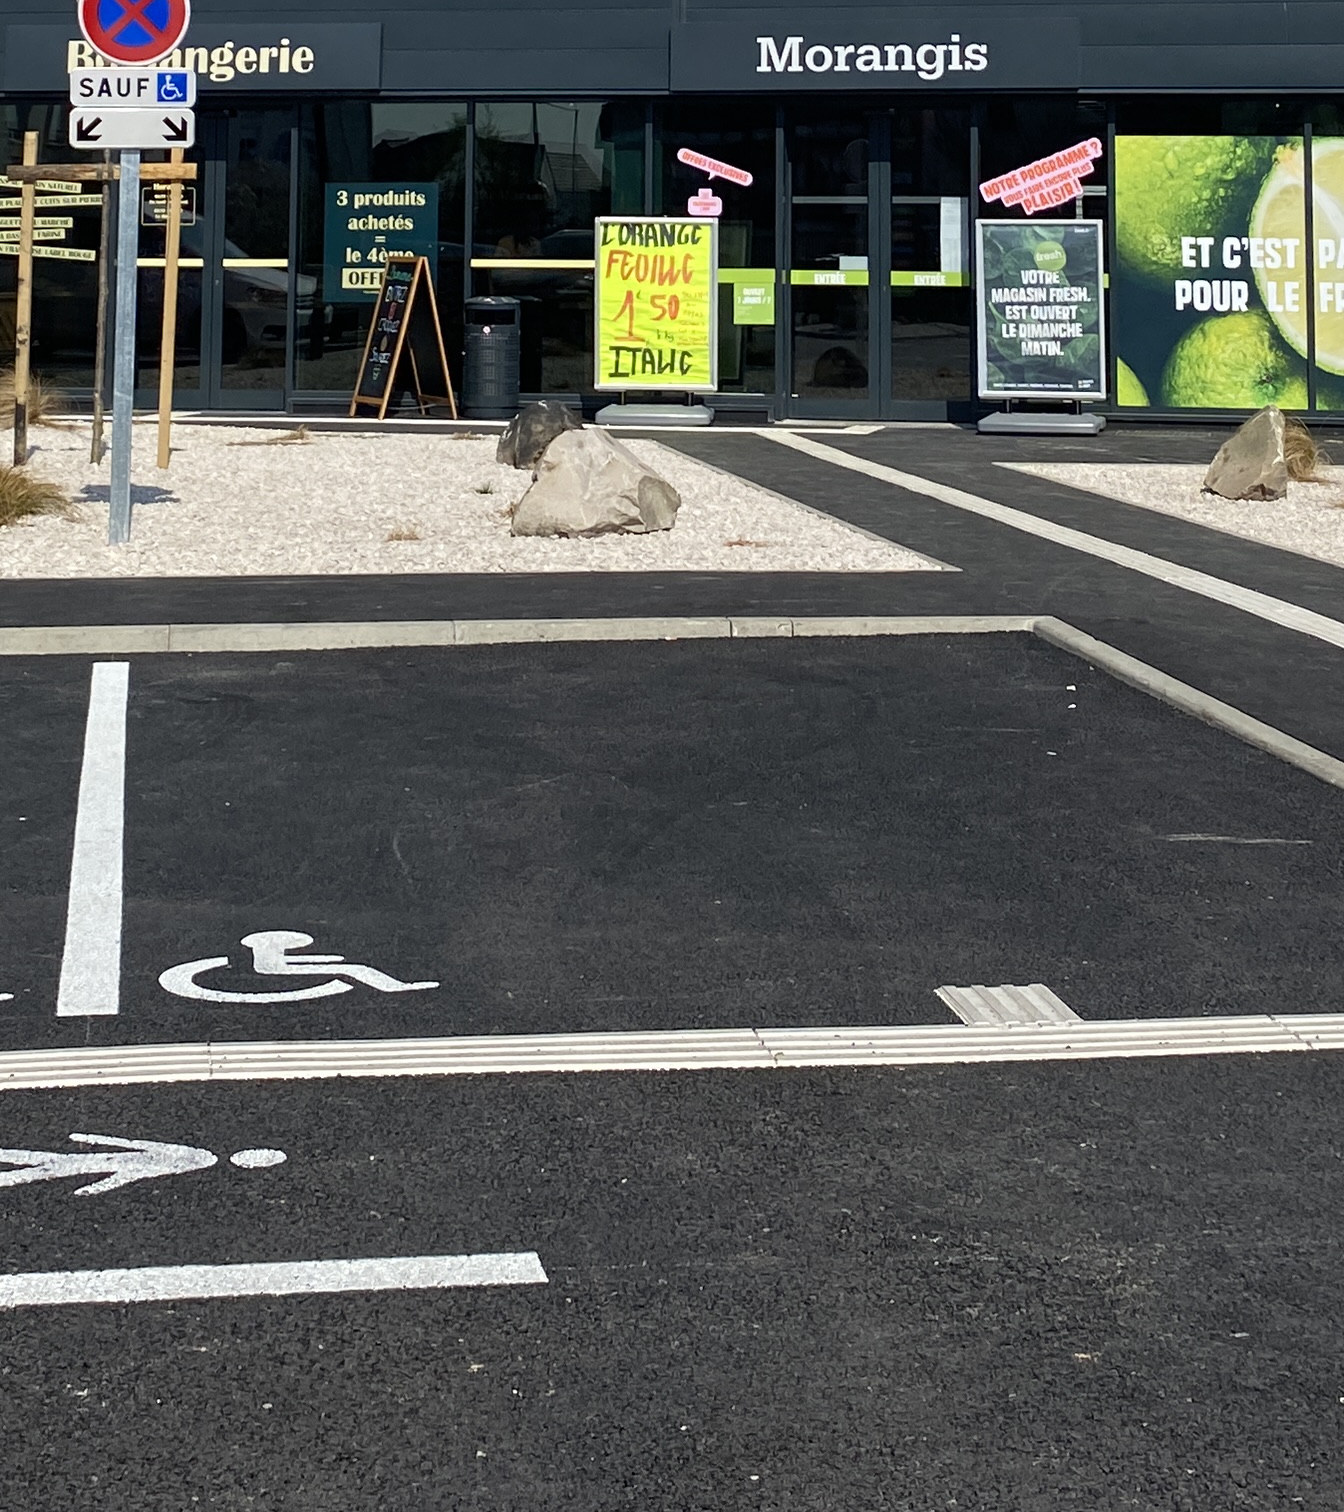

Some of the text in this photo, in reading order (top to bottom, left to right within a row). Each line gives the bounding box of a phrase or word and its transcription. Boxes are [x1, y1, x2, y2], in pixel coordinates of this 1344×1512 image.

[67, 38, 314, 82] Bangerie
[756, 34, 988, 80] Morangis
[79, 78, 149, 98] SAUF
[983, 175, 1019, 198] NOTRE
[1020, 145, 1090, 183] PROGRAMME
[337, 190, 426, 209] 3 produits
[1023, 182, 1074, 211] PLAISIR
[348, 214, 414, 230] achetés
[346, 247, 361, 263] le
[1181, 236, 1214, 268] ET
[1222, 236, 1300, 269] C'EST
[1021, 269, 1060, 285] VOTRE
[991, 287, 1091, 303] MAGASIN FRESH.
[1175, 279, 1249, 313] POUR
[1266, 281, 1300, 312] LE
[1005, 305, 1078, 320] EST OUVERT
[1002, 323, 1083, 338] LE DIMANCHE
[1021, 341, 1064, 356] MATIN.
